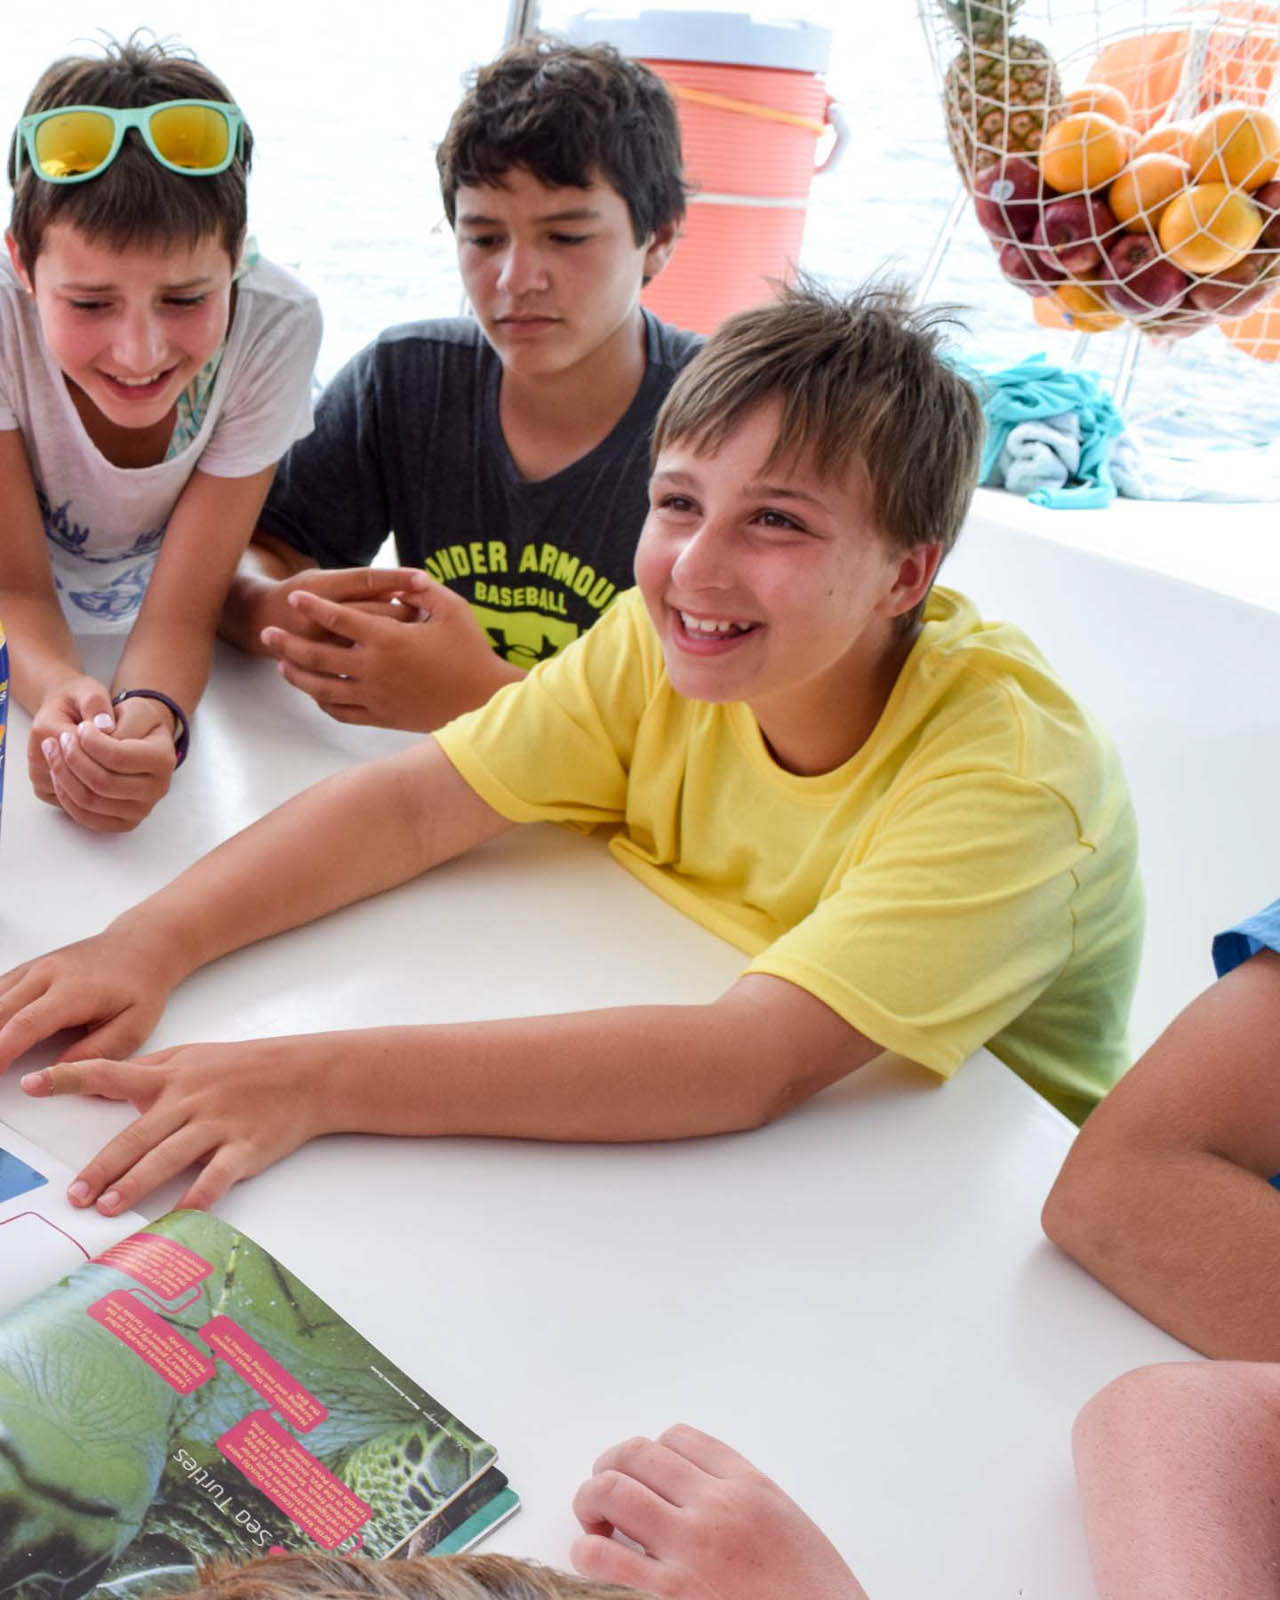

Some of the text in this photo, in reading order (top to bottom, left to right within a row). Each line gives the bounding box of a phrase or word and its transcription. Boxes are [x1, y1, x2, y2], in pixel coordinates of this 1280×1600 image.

[424, 541, 617, 616] UNDER ARMOU
[474, 581, 568, 614] BASEBALL
[172, 1449, 273, 1548] Sea Turtles
